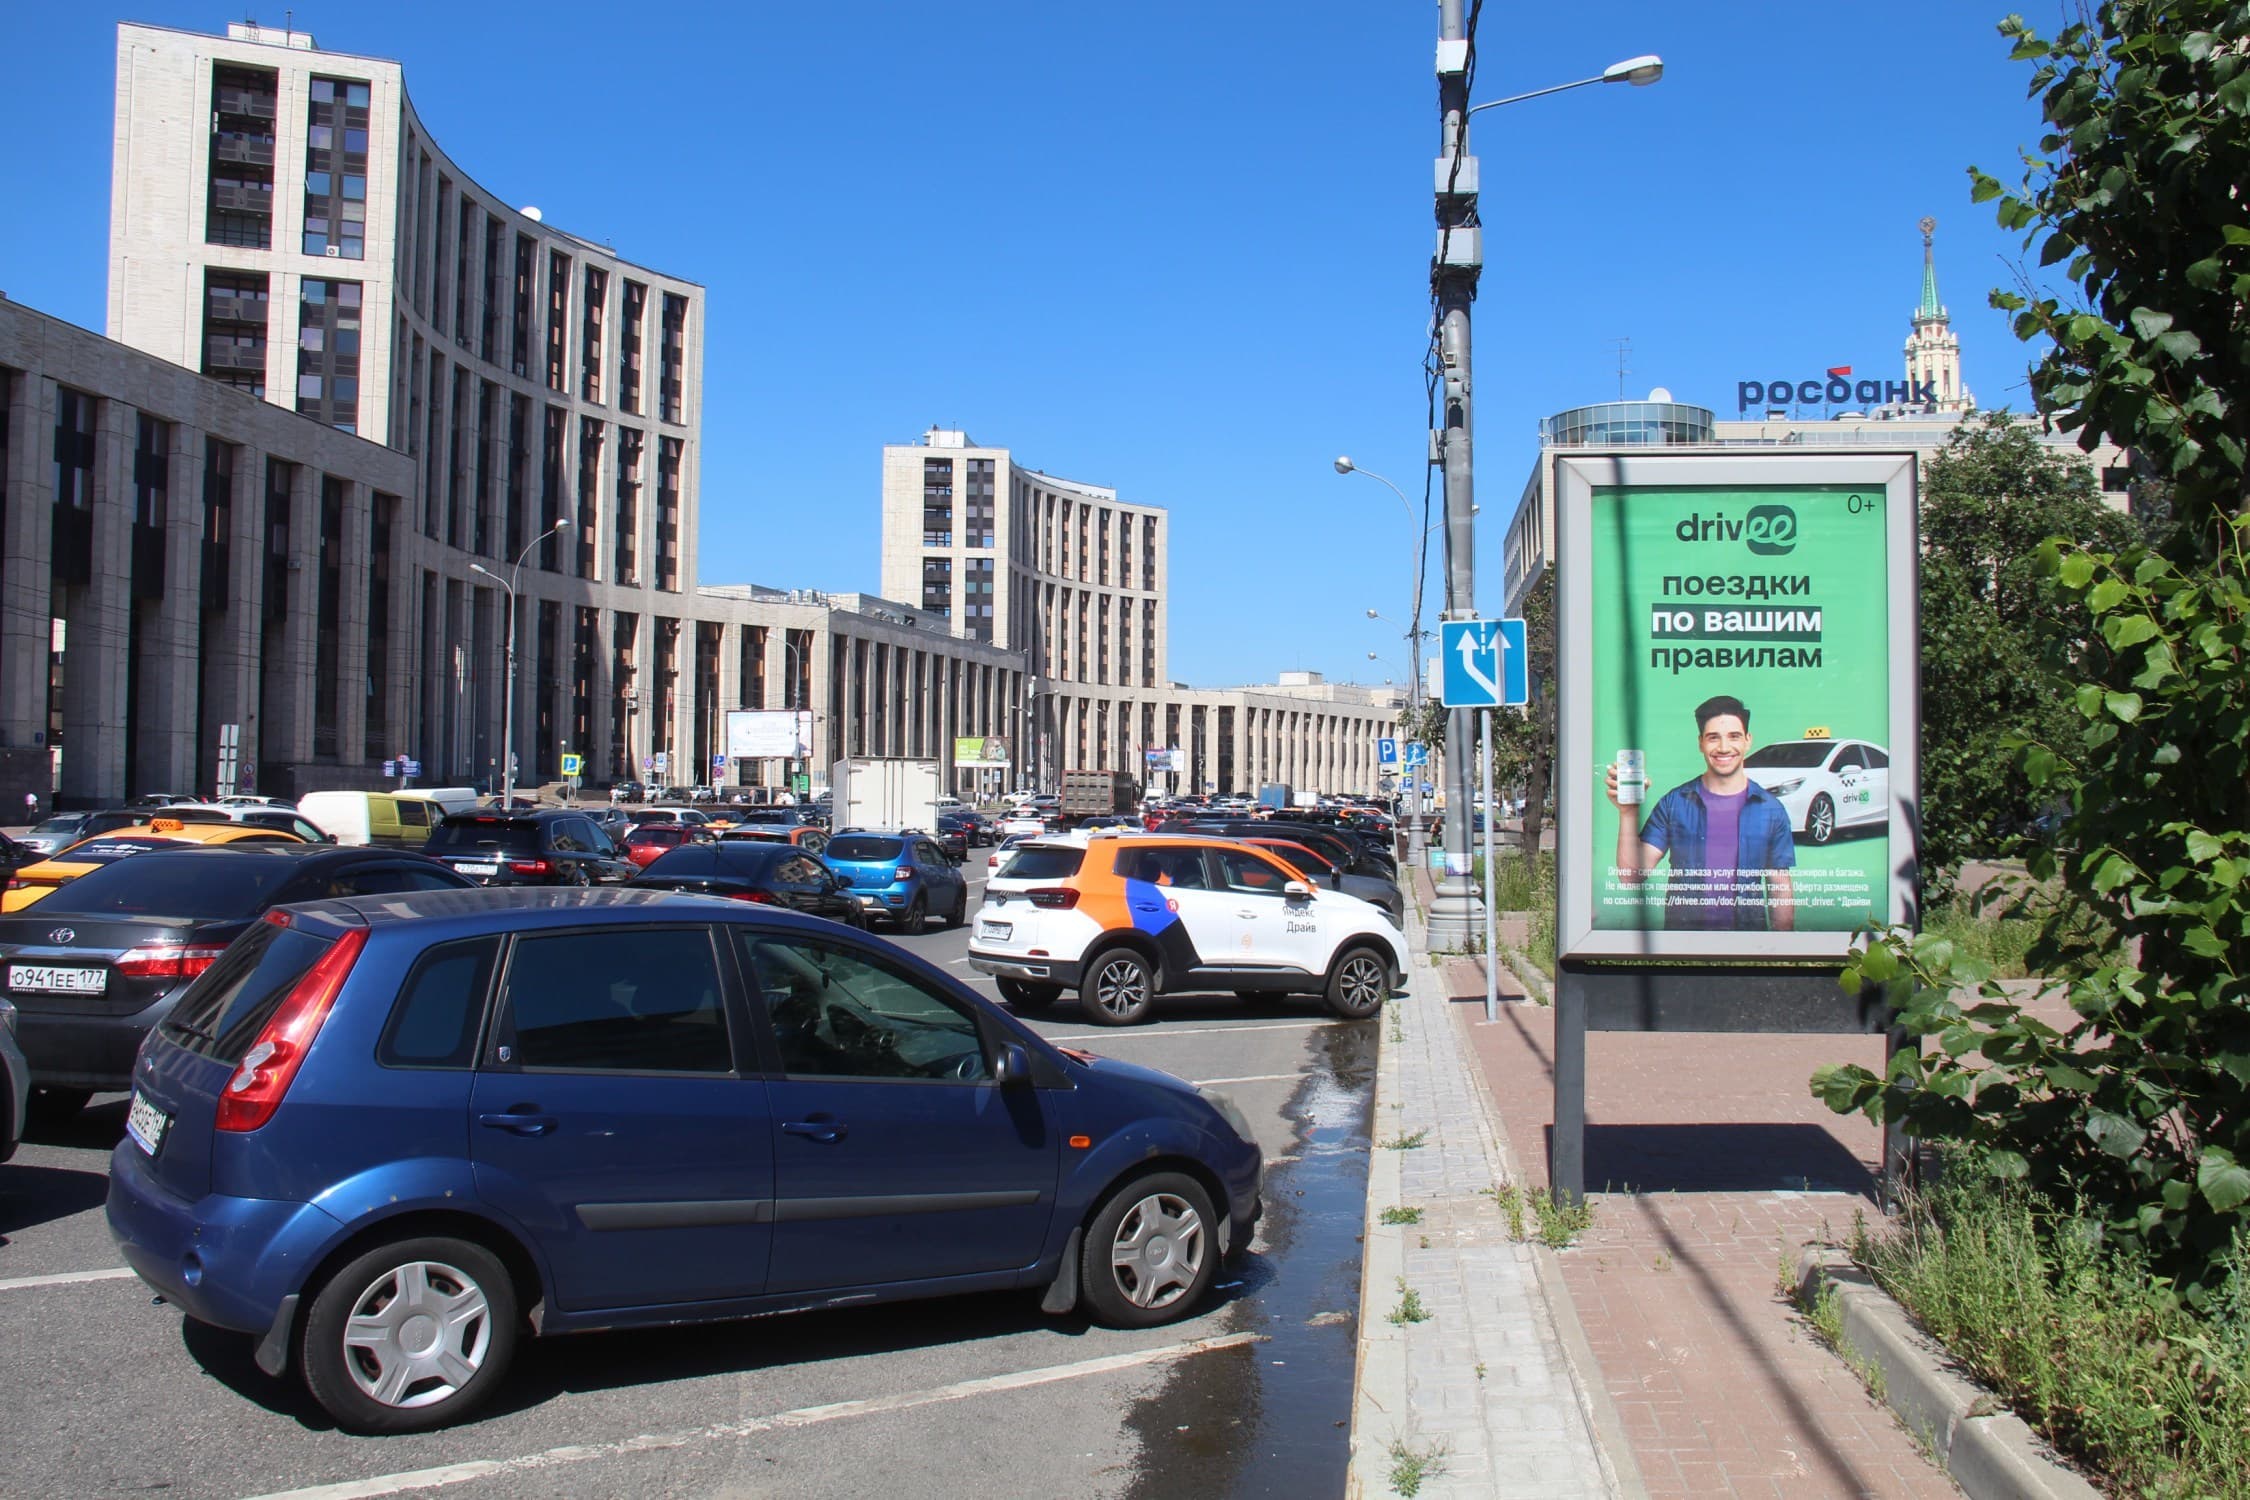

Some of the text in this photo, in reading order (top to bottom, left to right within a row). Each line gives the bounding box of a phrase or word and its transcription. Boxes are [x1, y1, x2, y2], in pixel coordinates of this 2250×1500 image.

[1738, 366, 1939, 412] росбанк
[1847, 494, 1875, 514] 0+
[1675, 510, 1797, 552] drivee
[1663, 574, 1810, 600] поездки
[1652, 611, 1821, 632] по вашим
[1651, 647, 1822, 675] правилам
[1667, 868, 1683, 877] для
[1684, 868, 1712, 877] заказа
[1713, 868, 1735, 879] услуг
[1736, 869, 1778, 878] перевозки
[1655, 882, 1712, 892] перевозчиком
[1713, 883, 1729, 891] или
[1603, 896, 1613, 905] по
[1282, 905, 1315, 918] Яндекс
[1286, 920, 1317, 934] Драйв
[79, 969, 104, 984] 177
